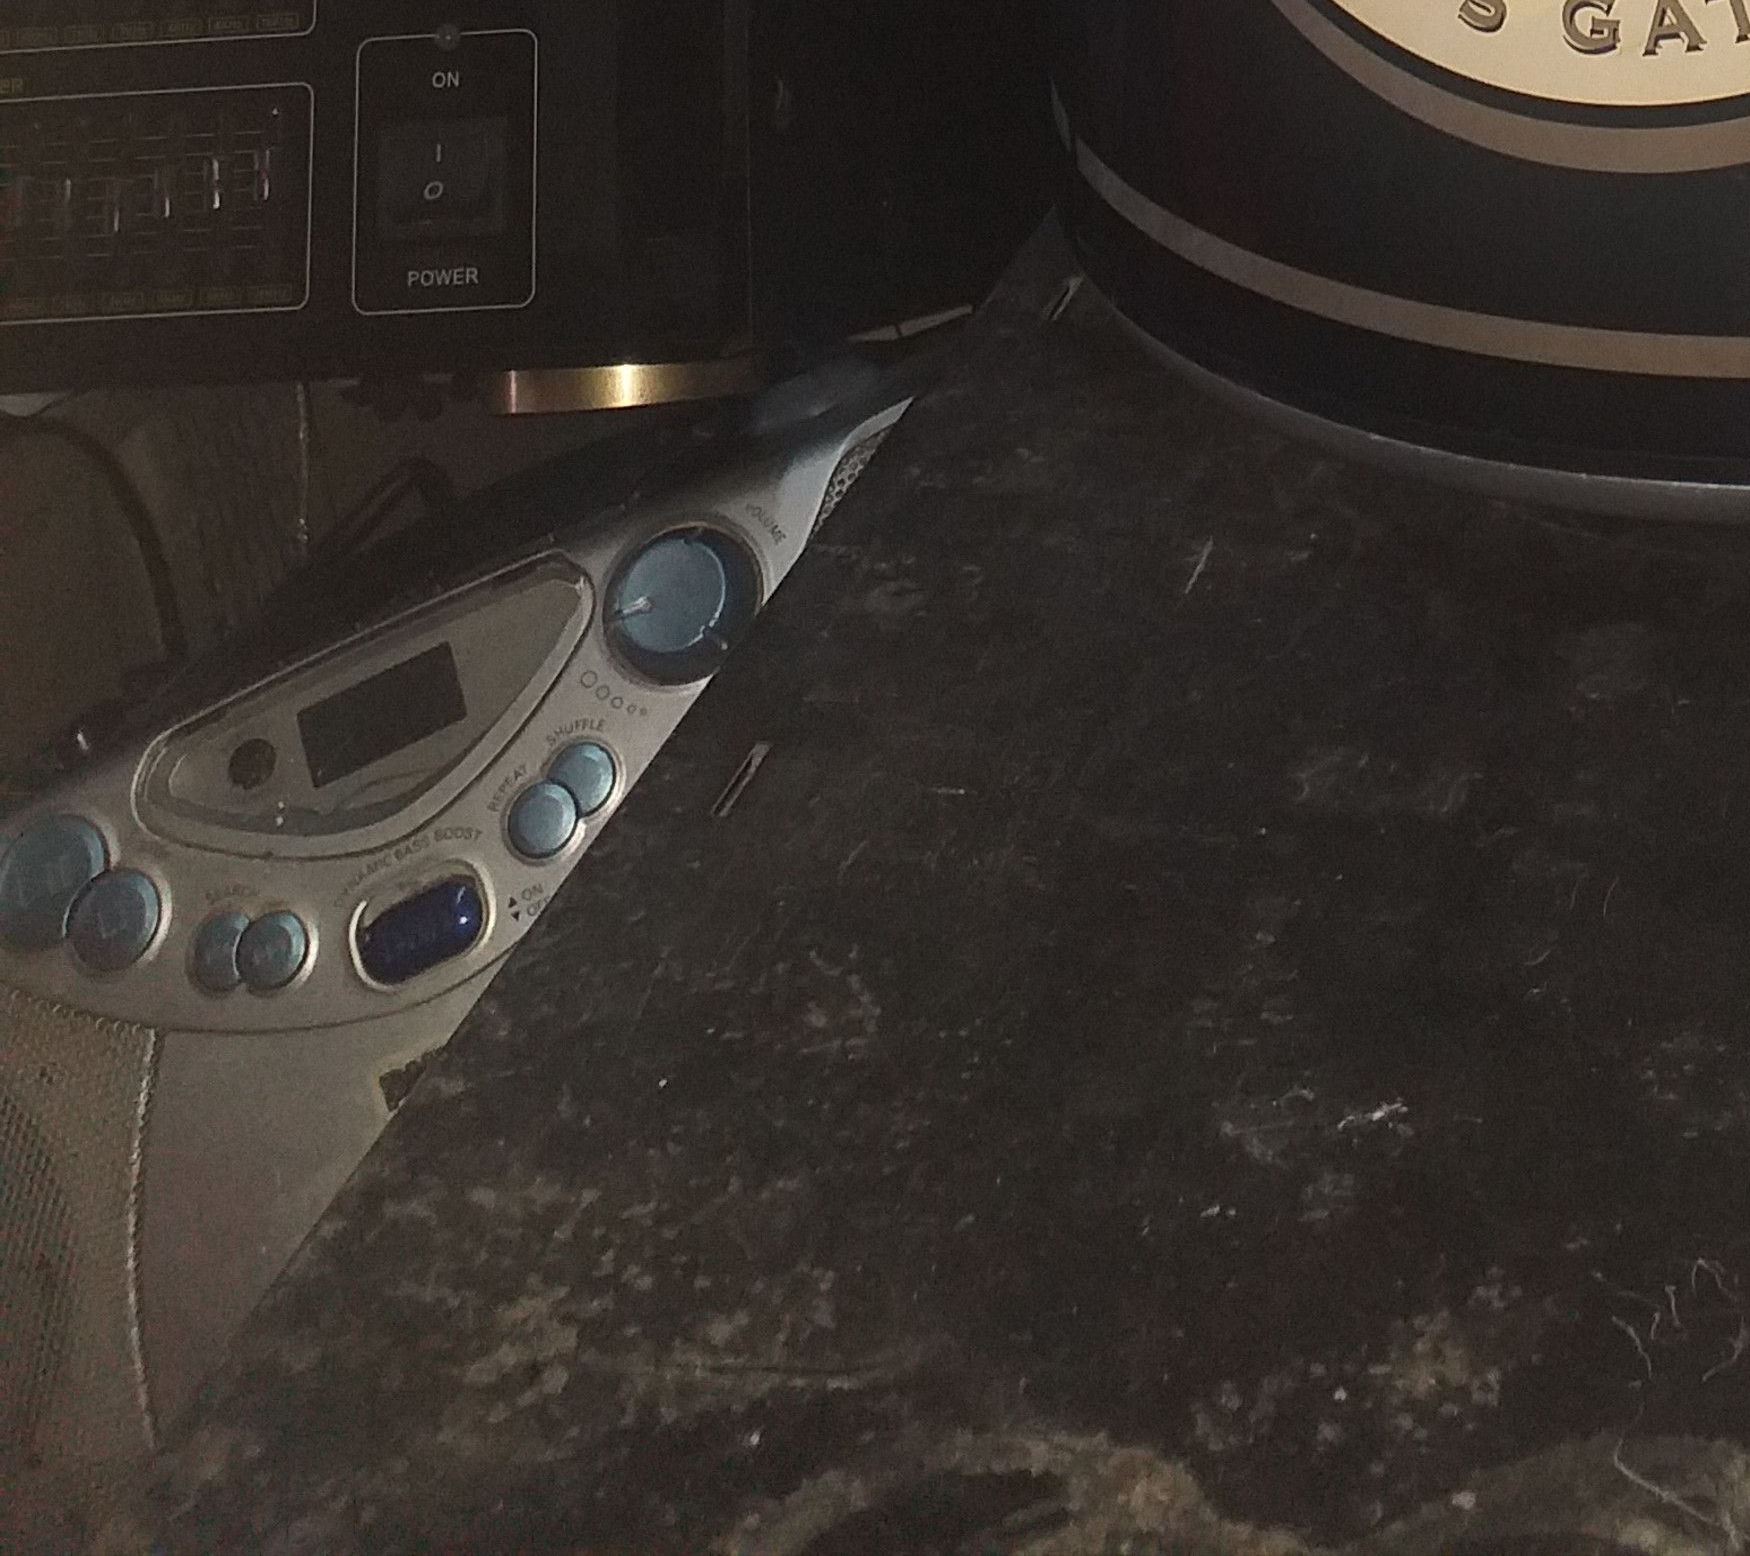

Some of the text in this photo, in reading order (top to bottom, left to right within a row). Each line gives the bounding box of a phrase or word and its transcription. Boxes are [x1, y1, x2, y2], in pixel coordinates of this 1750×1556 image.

[431, 70, 460, 89] ON
[407, 267, 479, 287] POWER
[744, 503, 788, 546] VOLUME
[546, 718, 606, 745] SHUFFLE
[487, 764, 528, 813] REPEAT
[394, 834, 431, 861] BASS
[434, 826, 483, 843] BOOST
[521, 883, 545, 902] ON
